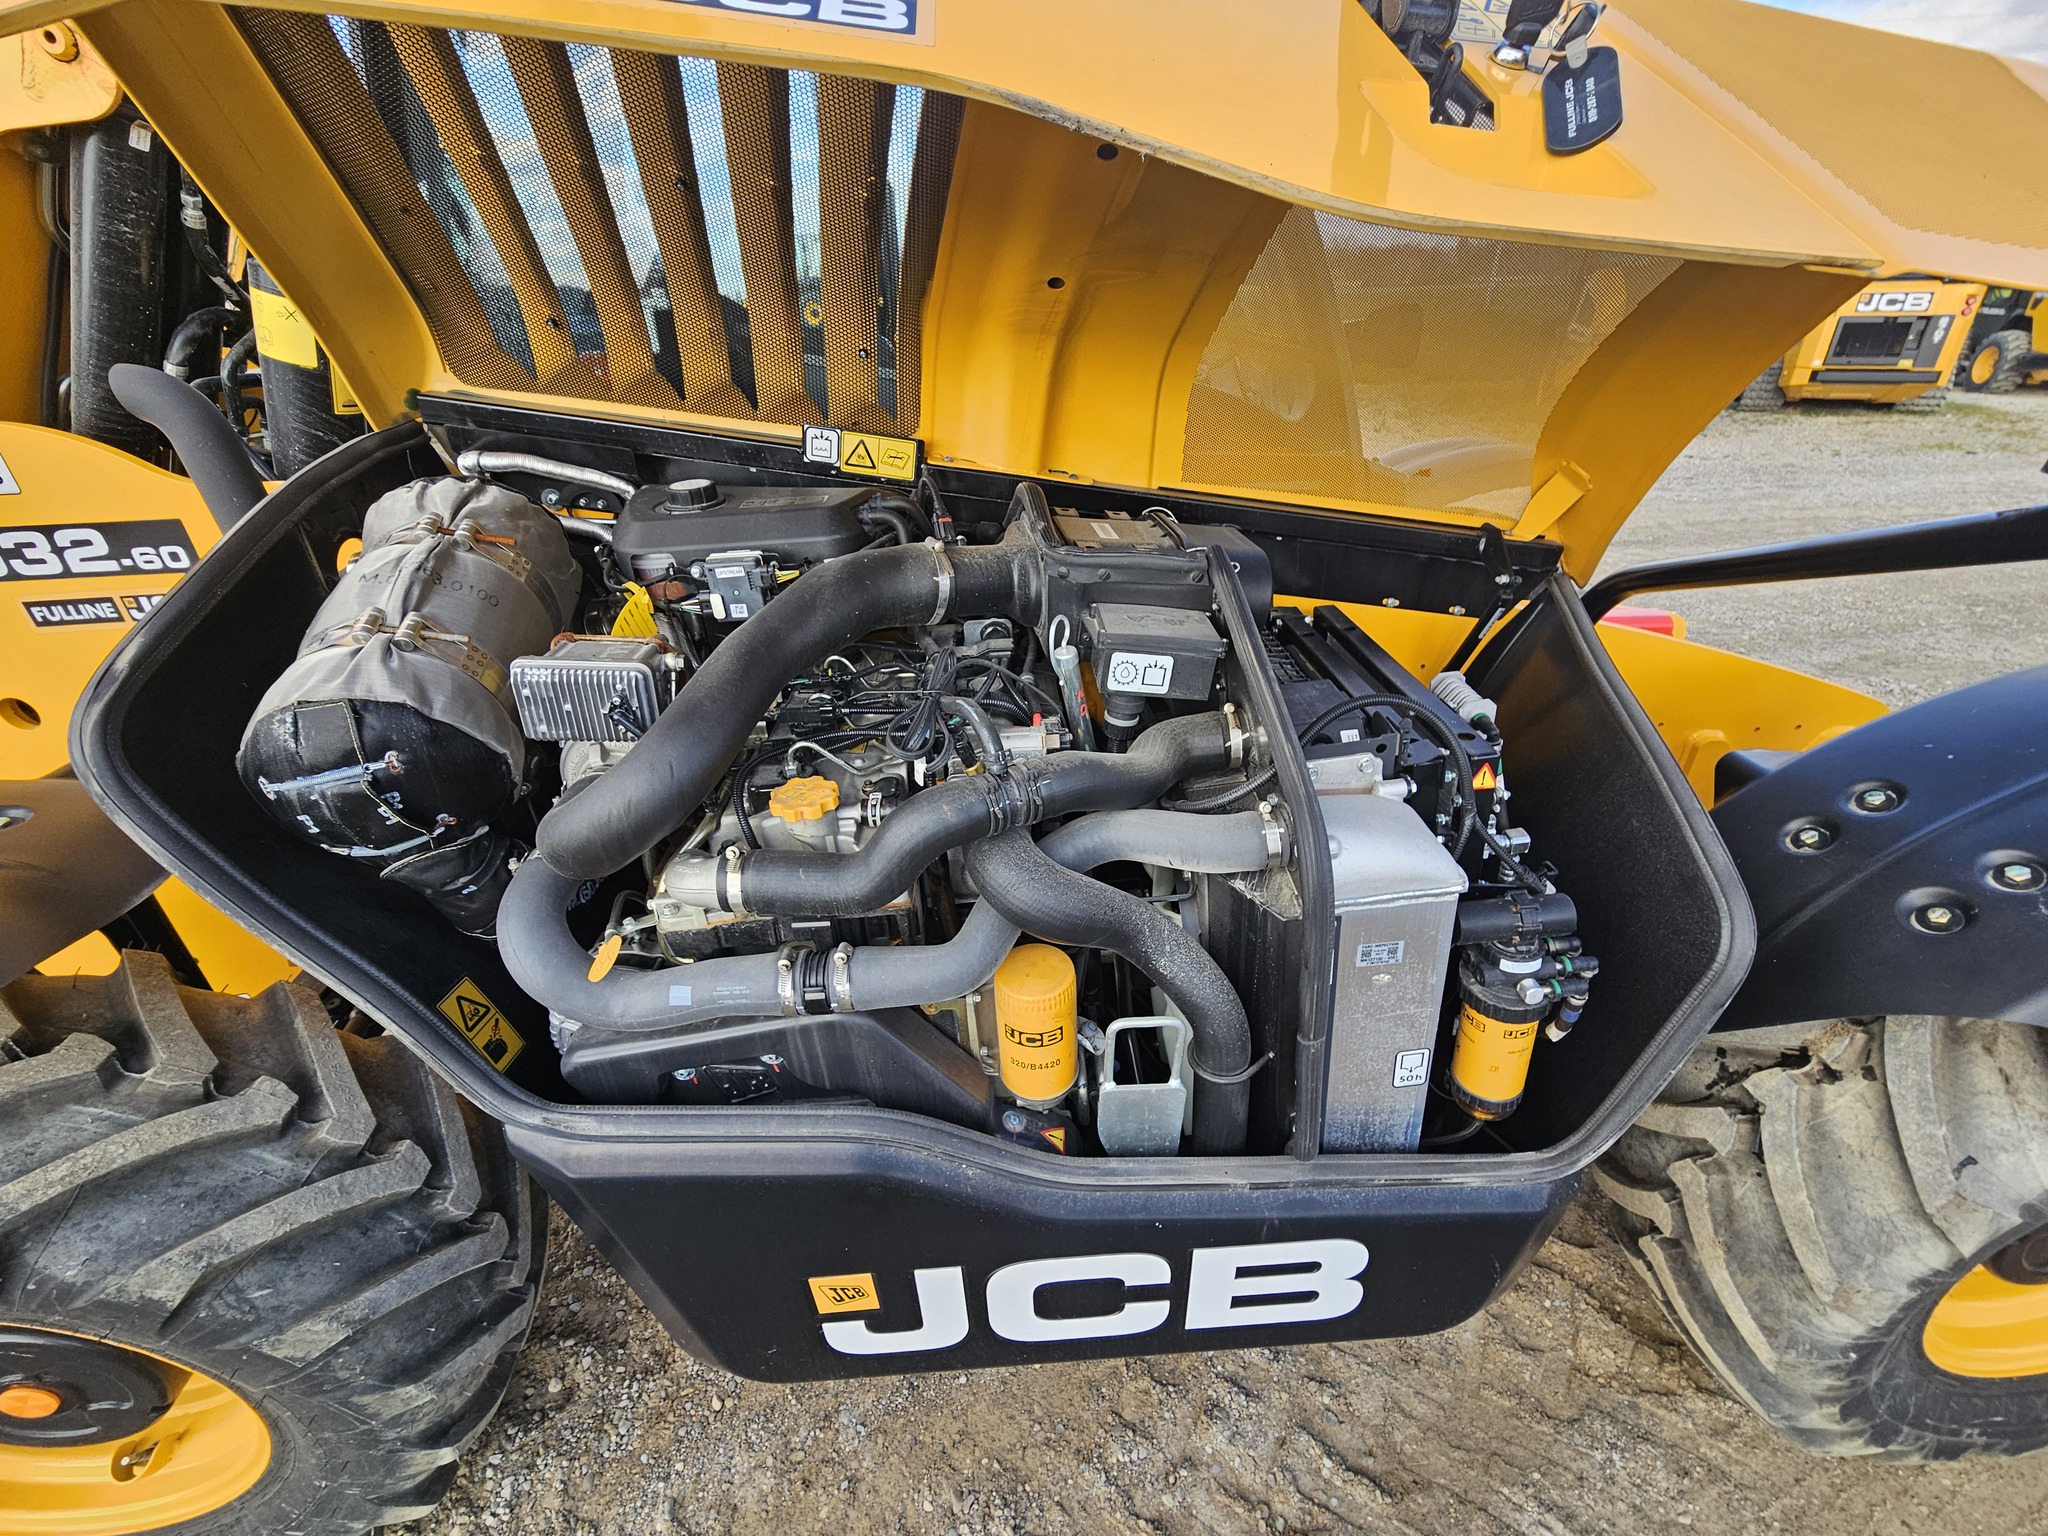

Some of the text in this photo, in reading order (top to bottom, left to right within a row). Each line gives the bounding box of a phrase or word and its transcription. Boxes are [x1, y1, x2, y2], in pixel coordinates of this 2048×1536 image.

[1856, 292, 1933, 312] JCB
[30, 602, 119, 622] FULLINE
[1005, 1024, 1063, 1048] JCB
[1010, 1057, 1061, 1071] 320/B4420
[822, 1238, 1370, 1355] JCB
[828, 1287, 866, 1303] JCB
